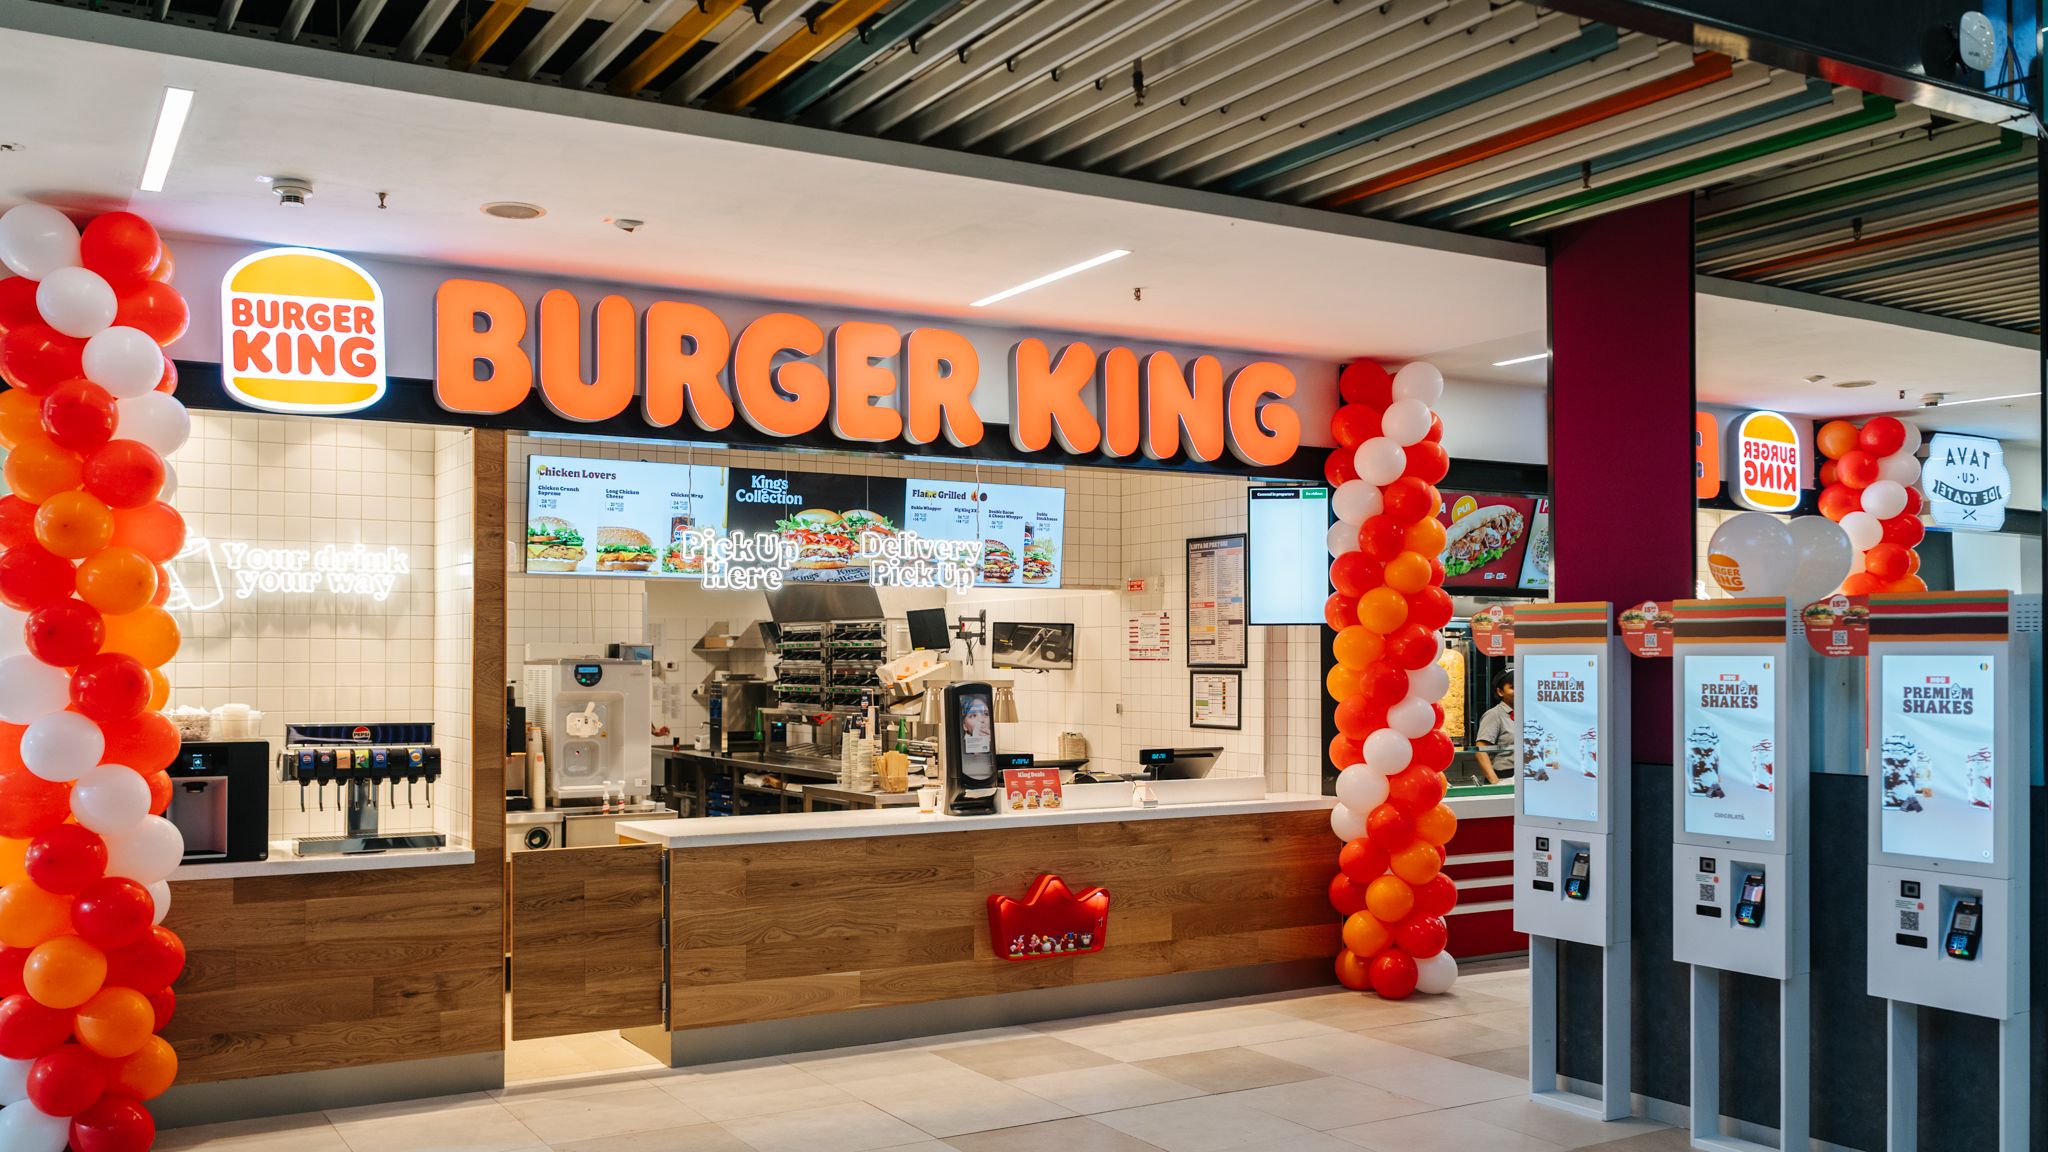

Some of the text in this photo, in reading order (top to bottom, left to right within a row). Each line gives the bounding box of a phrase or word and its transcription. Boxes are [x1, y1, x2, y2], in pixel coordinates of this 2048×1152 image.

[231, 297, 376, 335] BURGER
[232, 329, 377, 378] KING
[434, 278, 1301, 468] BURGER KING
[582, 470, 616, 480] Lovers
[735, 488, 803, 506] Collection
[938, 491, 966, 500] Grilled
[1457, 503, 1471, 516] PUI
[220, 542, 410, 574] Your drink
[680, 529, 800, 570] Pick Up
[860, 529, 984, 567] Delivery
[235, 569, 396, 601] your way
[701, 559, 784, 591] Here
[827, 571, 871, 583] Collecti
[869, 558, 977, 596] Pick Up
[1537, 690, 1585, 703] SHAKES
[1701, 695, 1758, 709] SHAKES
[1903, 699, 1974, 715] SHAKES
